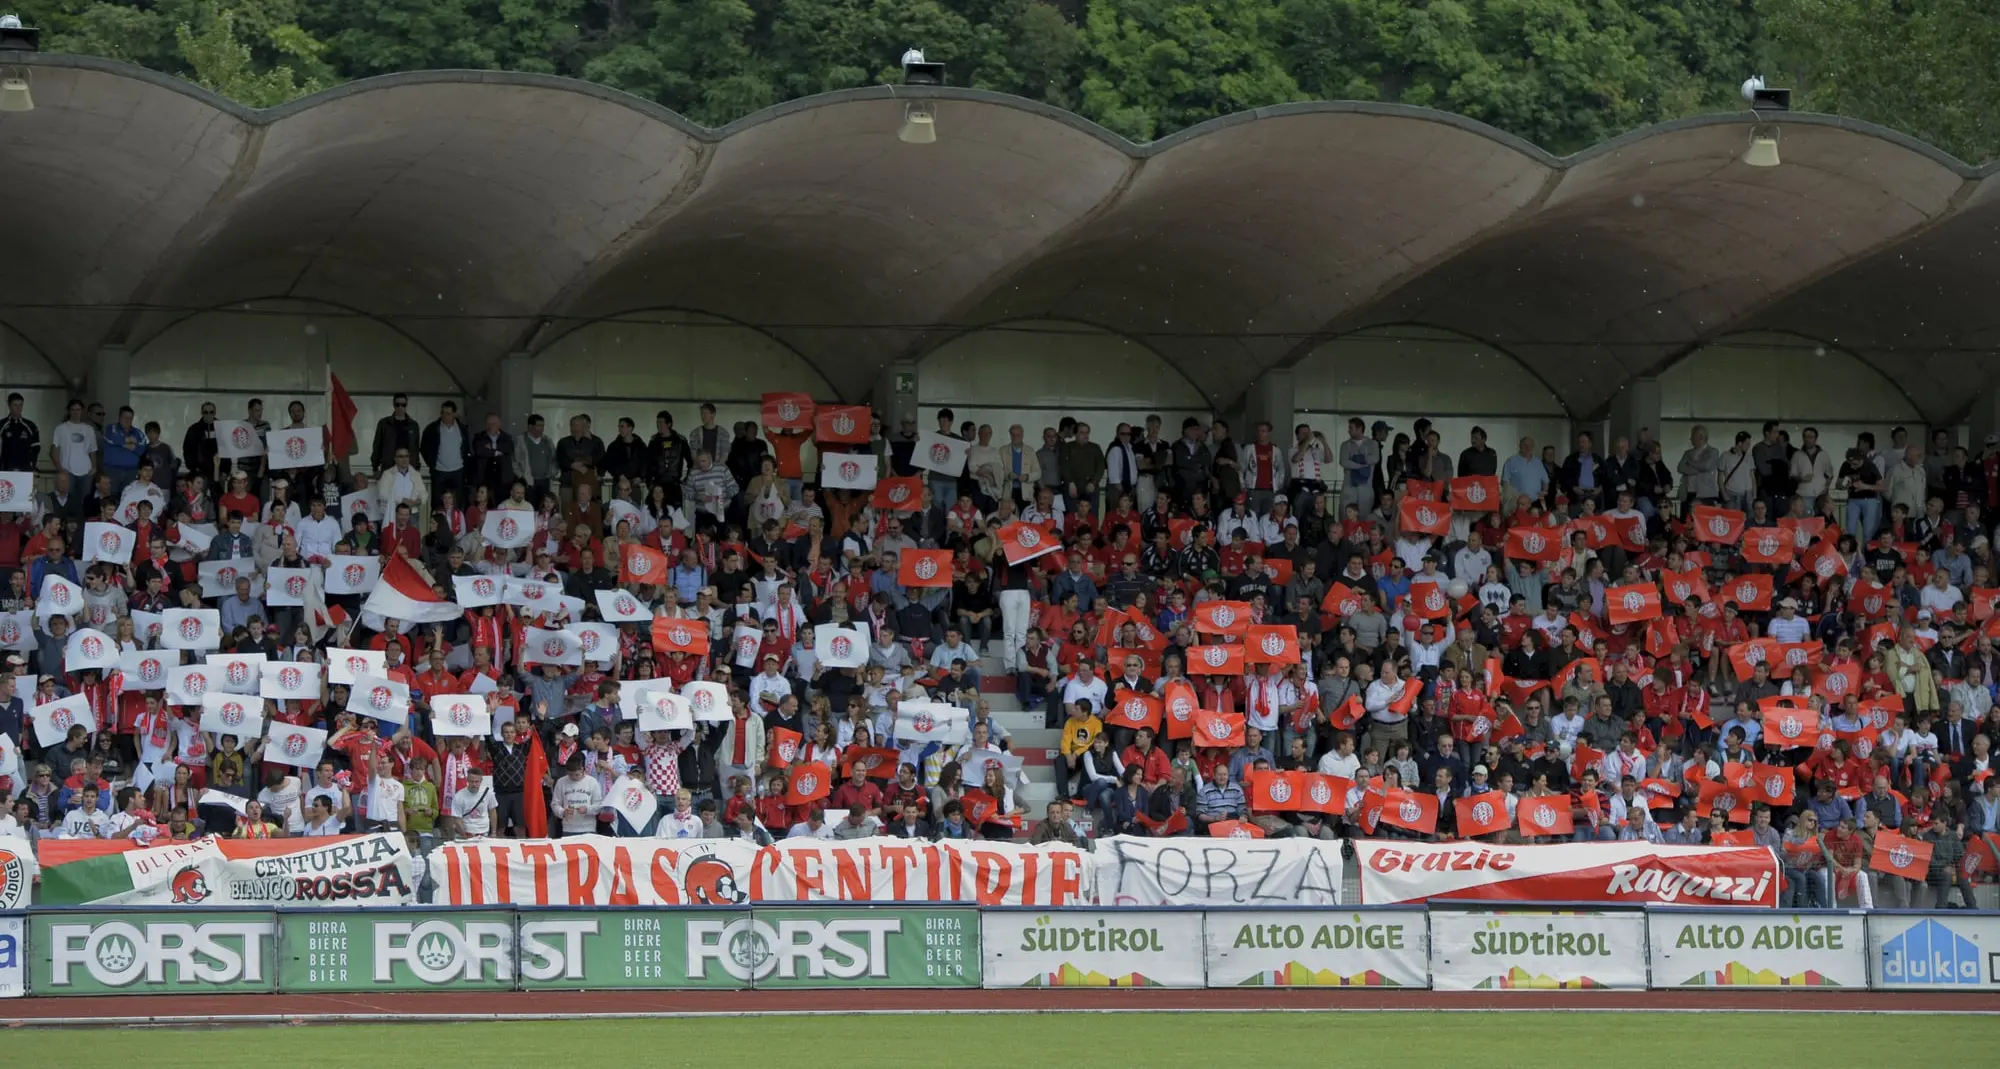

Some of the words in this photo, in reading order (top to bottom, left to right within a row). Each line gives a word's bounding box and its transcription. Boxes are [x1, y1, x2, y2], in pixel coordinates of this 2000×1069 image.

[135, 836, 215, 875] ULTRAS
[255, 836, 400, 878] CENTURIA
[1369, 848, 1515, 873] Grazie
[1113, 839, 1336, 905] FORZA
[1606, 863, 1774, 901] Ragazzi
[309, 921, 347, 934] BIRRA
[624, 918, 661, 931] BIRRA
[926, 917, 961, 930] BIRRA
[51, 921, 283, 985] FORST
[310, 953, 347, 966] BEER
[372, 919, 599, 984] FORST
[624, 949, 661, 963] BEER
[685, 918, 903, 983] FORST
[926, 948, 962, 961] BEER
[624, 965, 662, 979] BIER
[926, 963, 963, 977] BIER
[1885, 950, 1978, 978] duka
[310, 969, 348, 982] BIER
